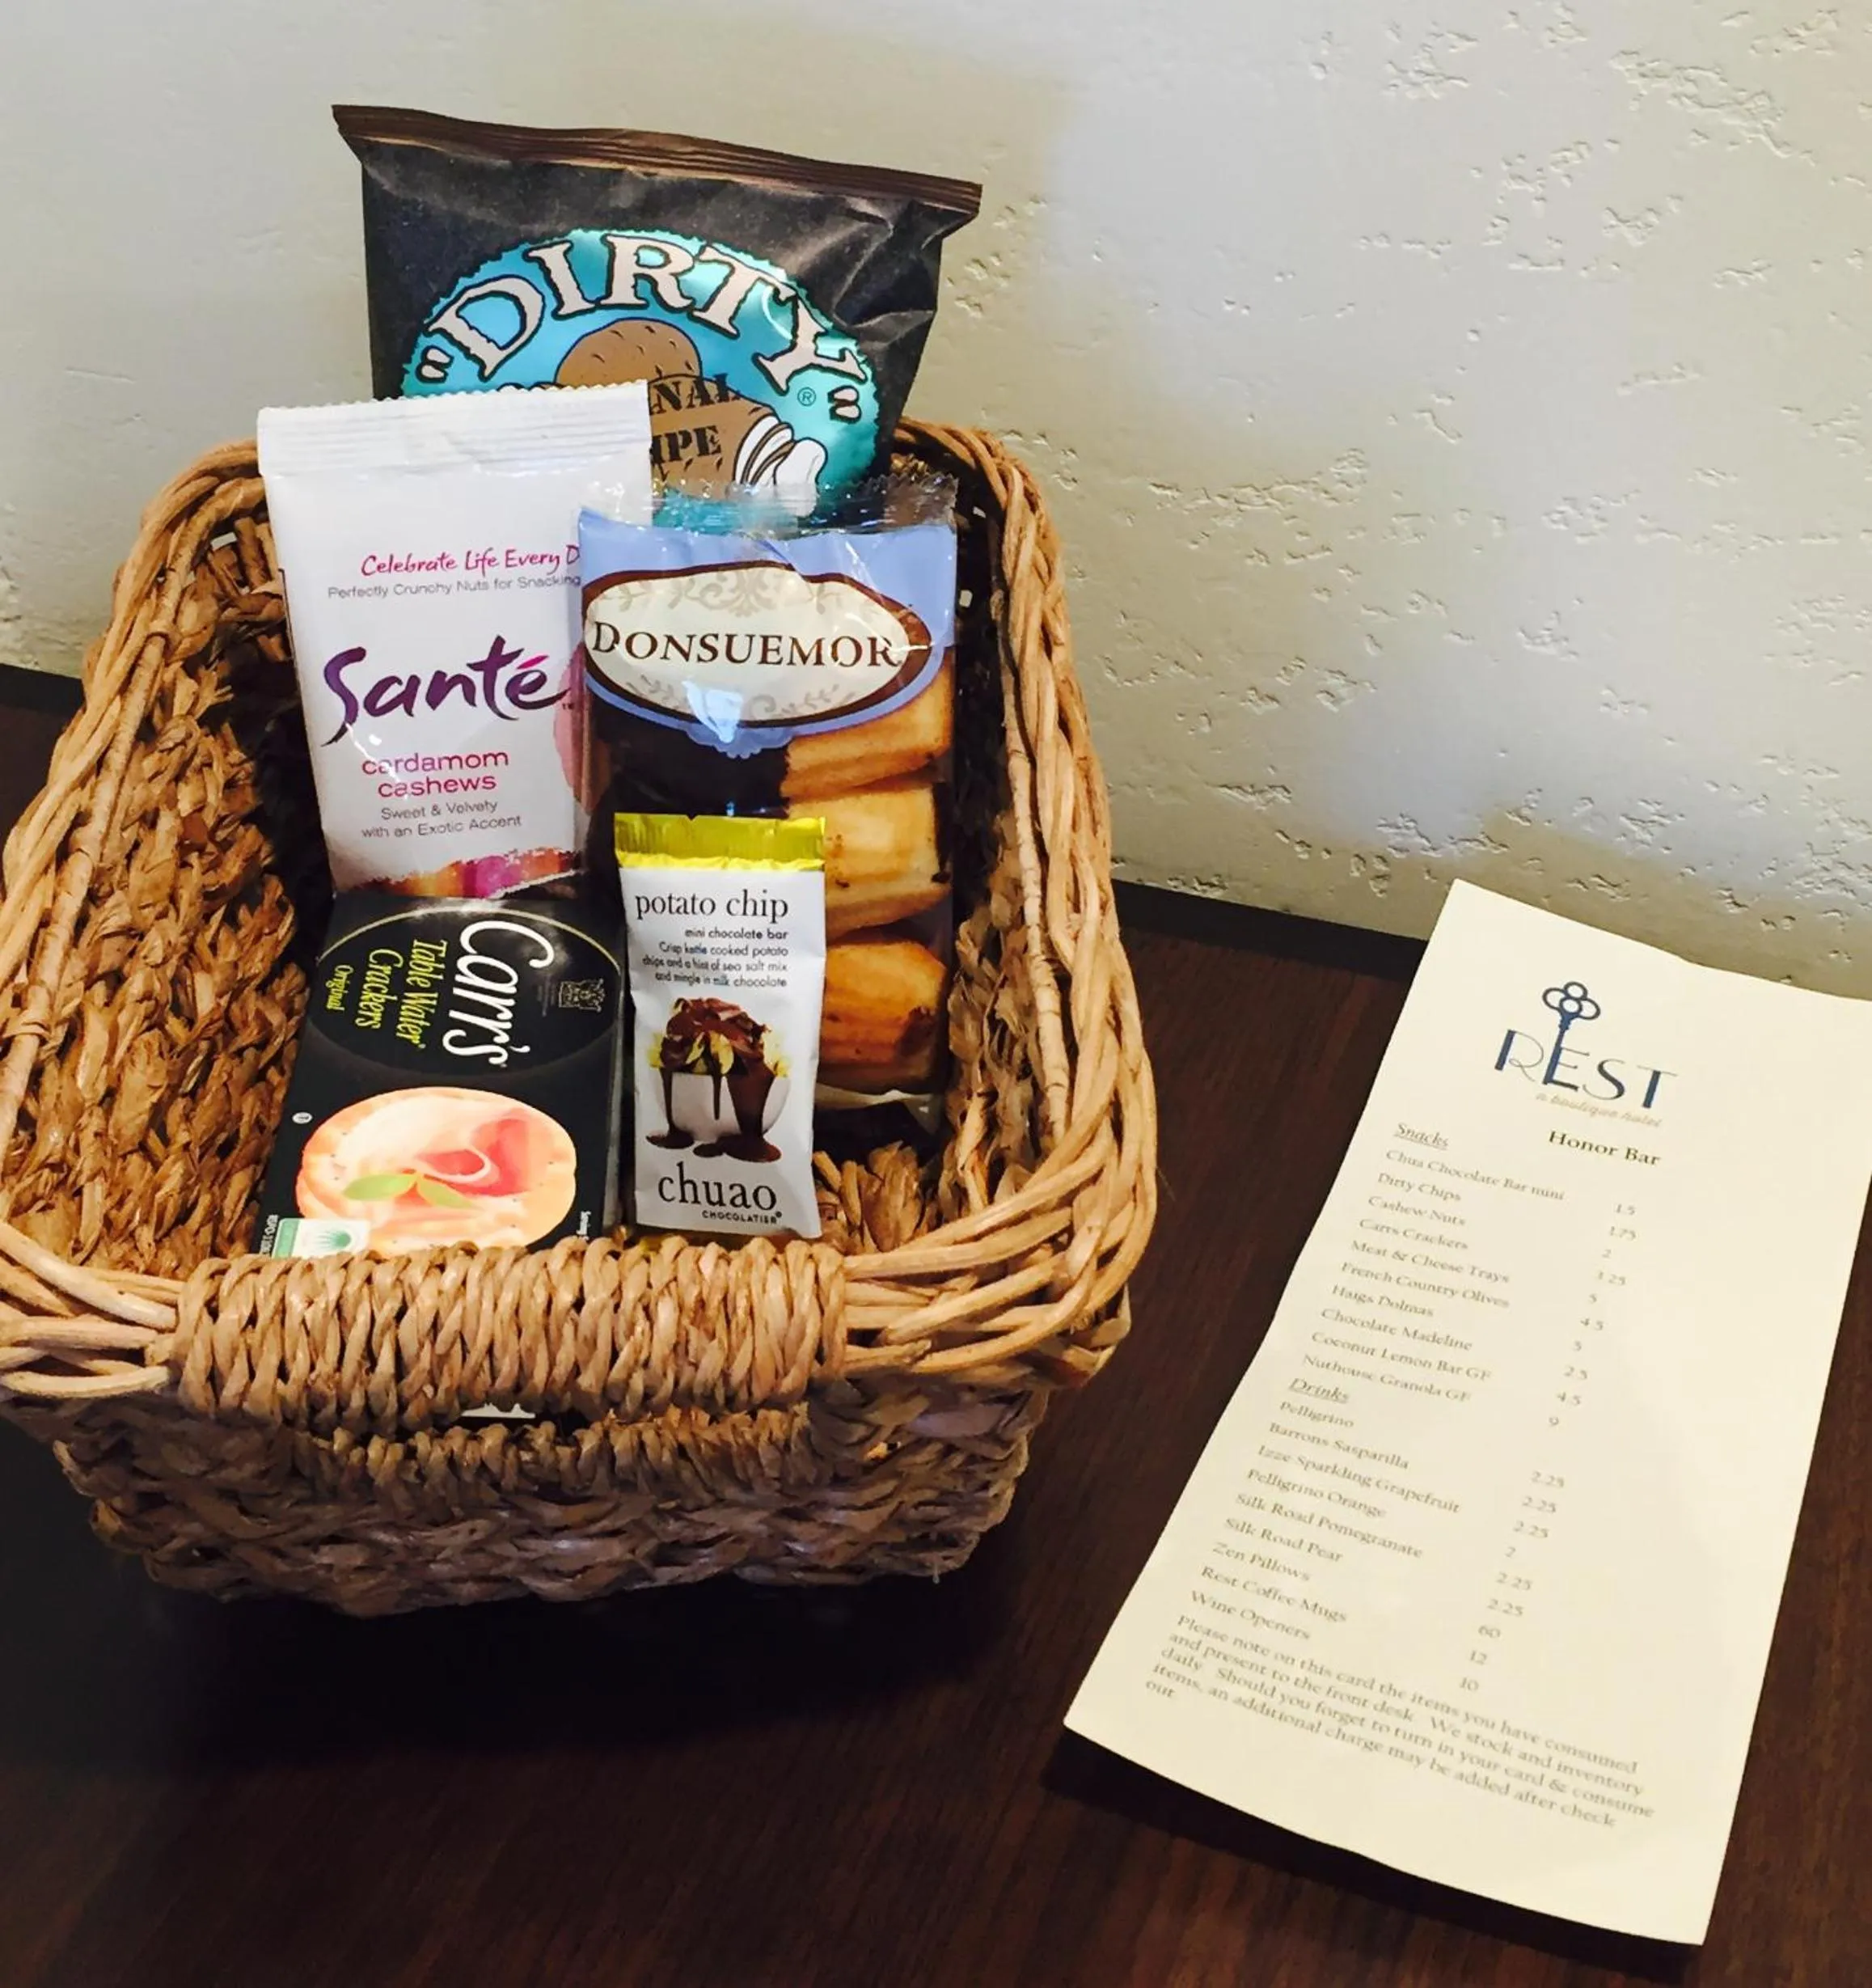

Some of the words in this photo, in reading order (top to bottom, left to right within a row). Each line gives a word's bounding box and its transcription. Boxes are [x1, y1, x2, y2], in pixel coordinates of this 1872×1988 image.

[361, 552, 458, 577] Celebrate
[466, 548, 499, 577] Life
[505, 549, 560, 575] Every
[327, 584, 388, 599] Perfectly
[393, 582, 452, 597] Crunchy
[457, 580, 489, 592] Nuts
[494, 577, 513, 590] for
[518, 574, 581, 588] Snacking
[592, 621, 902, 669] DONSUEMOR
[320, 635, 570, 747] Santé
[361, 751, 509, 776] cardamom
[378, 775, 497, 798] cashews
[361, 827, 390, 839] with
[394, 827, 412, 838] an
[418, 821, 464, 836] Exotic
[469, 815, 522, 831] Accent
[381, 807, 426, 820] Sweet
[431, 805, 442, 817] &
[446, 800, 498, 814] Velvety
[635, 892, 716, 920] potato
[726, 889, 789, 924] chip
[708, 927, 763, 939] chocolate
[767, 928, 789, 940] bar
[710, 945, 749, 956] cooked
[753, 945, 789, 958] potato
[406, 938, 448, 988] Table
[733, 975, 788, 988] chocolate
[746, 960, 763, 971] salt
[768, 962, 788, 971] mix
[325, 964, 354, 1011] Original
[355, 948, 404, 1030] Crackers
[395, 992, 440, 1047] Water
[1494, 1027, 1678, 1109] REST
[1394, 1123, 1448, 1150] Snacks
[1549, 1131, 1619, 1156] Honor
[1625, 1146, 1661, 1165] Bar
[657, 1161, 777, 1211] chuao
[1377, 1172, 1413, 1193] Dirty
[1418, 1183, 1461, 1201] Chips
[1426, 1161, 1500, 1186] Chocolate
[1503, 1177, 1528, 1192] Bar
[1531, 1186, 1564, 1201] mini
[1367, 1195, 1427, 1216] Cashew
[1429, 1209, 1465, 1226] Nuts
[1401, 1229, 1468, 1250] Crackers
[1353, 1240, 1388, 1257] Meat
[1391, 1250, 1409, 1262] &
[1410, 1254, 1464, 1274] Cheese
[1469, 1265, 1509, 1284] Trays
[1342, 1261, 1392, 1283] French
[1395, 1275, 1459, 1297] Country
[1461, 1290, 1509, 1307] Olives
[1377, 1295, 1434, 1317] Dolmas
[1321, 1309, 1397, 1336] Chocolate
[1402, 1326, 1473, 1351] Madeline
[1311, 1332, 1377, 1356] Coconut
[1380, 1347, 1433, 1369] Lemon
[1436, 1360, 1463, 1375] Bar
[1465, 1367, 1490, 1381] GF
[1288, 1377, 1349, 1404] Drinks
[1304, 1354, 1373, 1381] Nuthouse
[1380, 1374, 1442, 1397] Granola
[1444, 1389, 1468, 1402] GF
[1269, 1422, 1329, 1447] Barrons
[1257, 1444, 1291, 1462] Izze
[1297, 1456, 1372, 1488] Sparkling
[1375, 1479, 1460, 1513] Grapefruit
[1327, 1492, 1382, 1517] Orange
[1226, 1518, 1257, 1537] Silk
[1260, 1528, 1304, 1550] Road
[1307, 1542, 1343, 1563] Pear
[1237, 1494, 1266, 1511] Silk
[1270, 1502, 1315, 1525] Road
[1317, 1516, 1422, 1558] Pomegranate
[1212, 1542, 1246, 1562] Zen
[1249, 1553, 1309, 1581] Pillows
[1201, 1565, 1238, 1587] Rest
[1241, 1580, 1295, 1606] Coffee
[1300, 1598, 1346, 1622] Mugs
[1192, 1590, 1237, 1615] Wine
[1239, 1609, 1310, 1640] Openers
[1177, 1614, 1228, 1643] Please
[1232, 1637, 1270, 1657] note
[1274, 1652, 1296, 1666] on
[1299, 1659, 1332, 1677] this
[1335, 1673, 1375, 1691] card
[1379, 1682, 1403, 1699] the
[1410, 1693, 1459, 1716] items
[1463, 1711, 1496, 1730] you
[1499, 1719, 1540, 1745] have
[1545, 1739, 1638, 1774] consumed
[1169, 1635, 1203, 1652] and
[1202, 1646, 1267, 1676] present
[1271, 1669, 1291, 1682] to
[1293, 1676, 1322, 1694] the
[1325, 1685, 1369, 1708] front
[1430, 1715, 1461, 1738] We
[1466, 1732, 1513, 1757] stock
[1517, 1752, 1553, 1770] and
[1556, 1760, 1642, 1798] inventory
[1218, 1668, 1277, 1699] Should
[1278, 1692, 1312, 1711] you
[1314, 1700, 1366, 1728] forget
[1393, 1727, 1433, 1749] turn
[1460, 1750, 1501, 1771] your
[1504, 1767, 1545, 1787] card
[1571, 1788, 1654, 1817] consume
[1232, 1696, 1323, 1734] additional
[1325, 1727, 1384, 1753] charge
[1388, 1746, 1425, 1767] may
[1454, 1770, 1511, 1796] added
[1514, 1791, 1557, 1810] after
[1560, 1804, 1616, 1827] check
